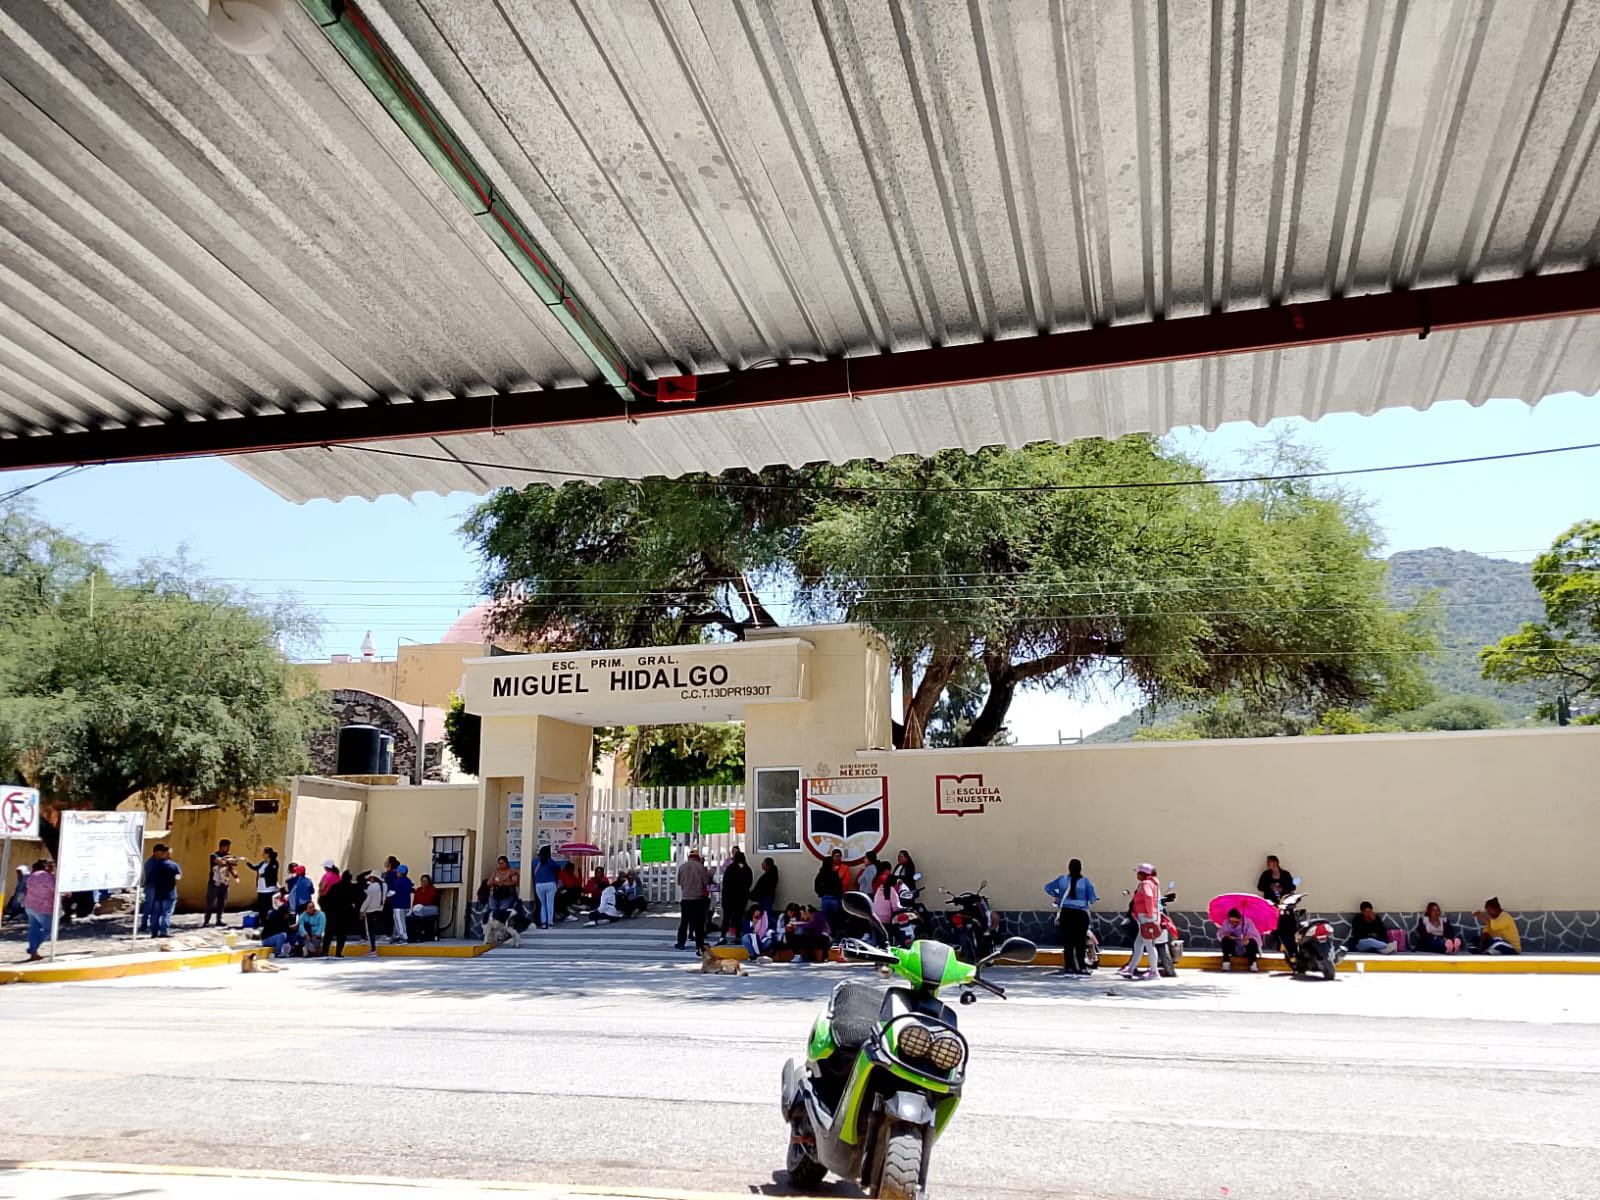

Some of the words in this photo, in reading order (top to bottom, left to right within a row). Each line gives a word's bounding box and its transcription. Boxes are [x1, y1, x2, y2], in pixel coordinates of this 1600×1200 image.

[551, 661, 579, 671] ESC.
[590, 659, 625, 669] PRIM.
[637, 655, 680, 666] GRAL.
[492, 673, 589, 697] MIGUEL
[610, 664, 728, 691] HIDALGO
[957, 787, 1000, 795] ESCUELA
[957, 795, 1002, 803] NUESTRA
